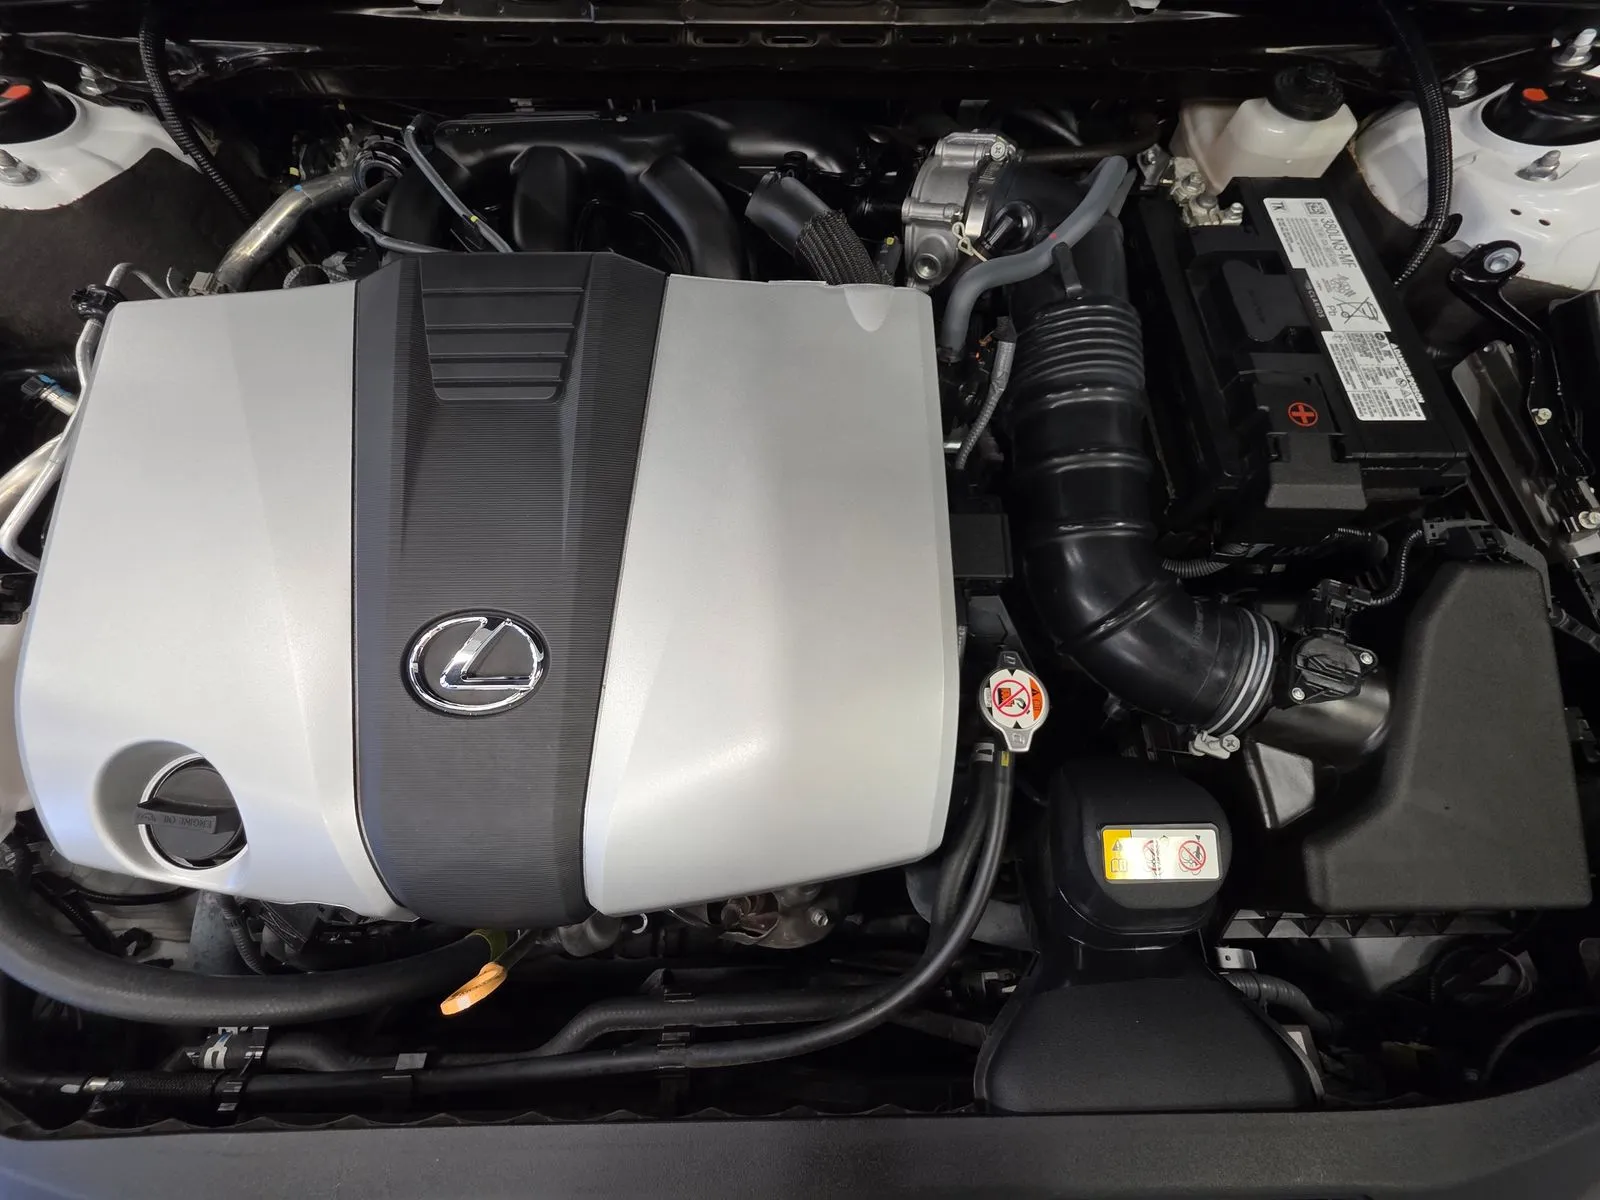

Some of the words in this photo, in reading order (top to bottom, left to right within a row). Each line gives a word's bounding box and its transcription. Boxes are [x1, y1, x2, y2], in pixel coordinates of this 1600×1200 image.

[1321, 218, 1357, 269] 380LN3-MF
[163, 815, 176, 825] OIL
[178, 816, 213, 829] ENGINE
